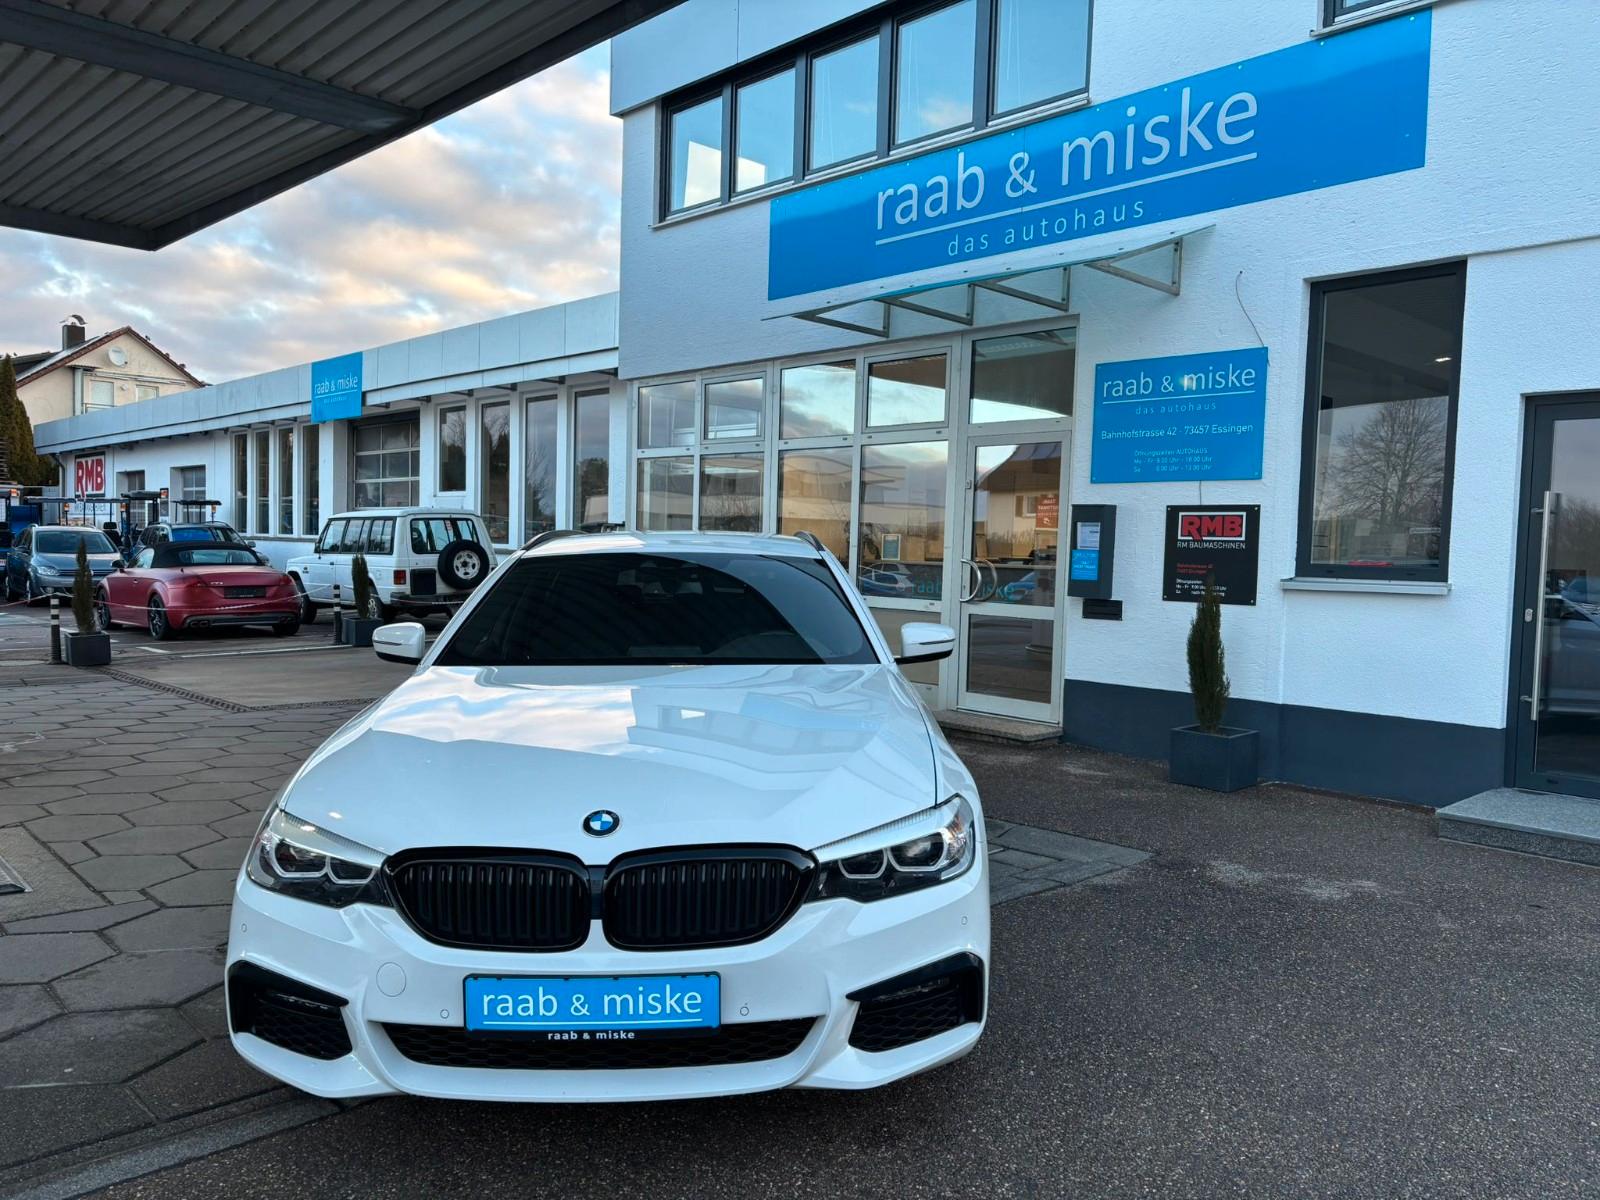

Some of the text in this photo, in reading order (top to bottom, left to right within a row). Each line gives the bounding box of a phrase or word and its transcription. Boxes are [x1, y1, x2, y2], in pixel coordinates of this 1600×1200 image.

[876, 87, 1258, 230] raab & miske
[948, 200, 1145, 256] das autohaus
[314, 377, 330, 395] raab
[337, 372, 358, 390] miske
[1103, 363, 1256, 398] raab & miske
[1135, 402, 1216, 415] das autohaus
[1101, 429, 1165, 440] Bahnhofstrasse
[1167, 427, 1177, 436] 42
[1211, 424, 1253, 435] Essingen
[77, 458, 104, 497] RMB
[1182, 514, 1243, 540] RMB
[1176, 541, 1246, 550] RM BAUMASCHINEN
[482, 983, 702, 1017] raab & miske
[547, 1030, 635, 1040] raab & miske
